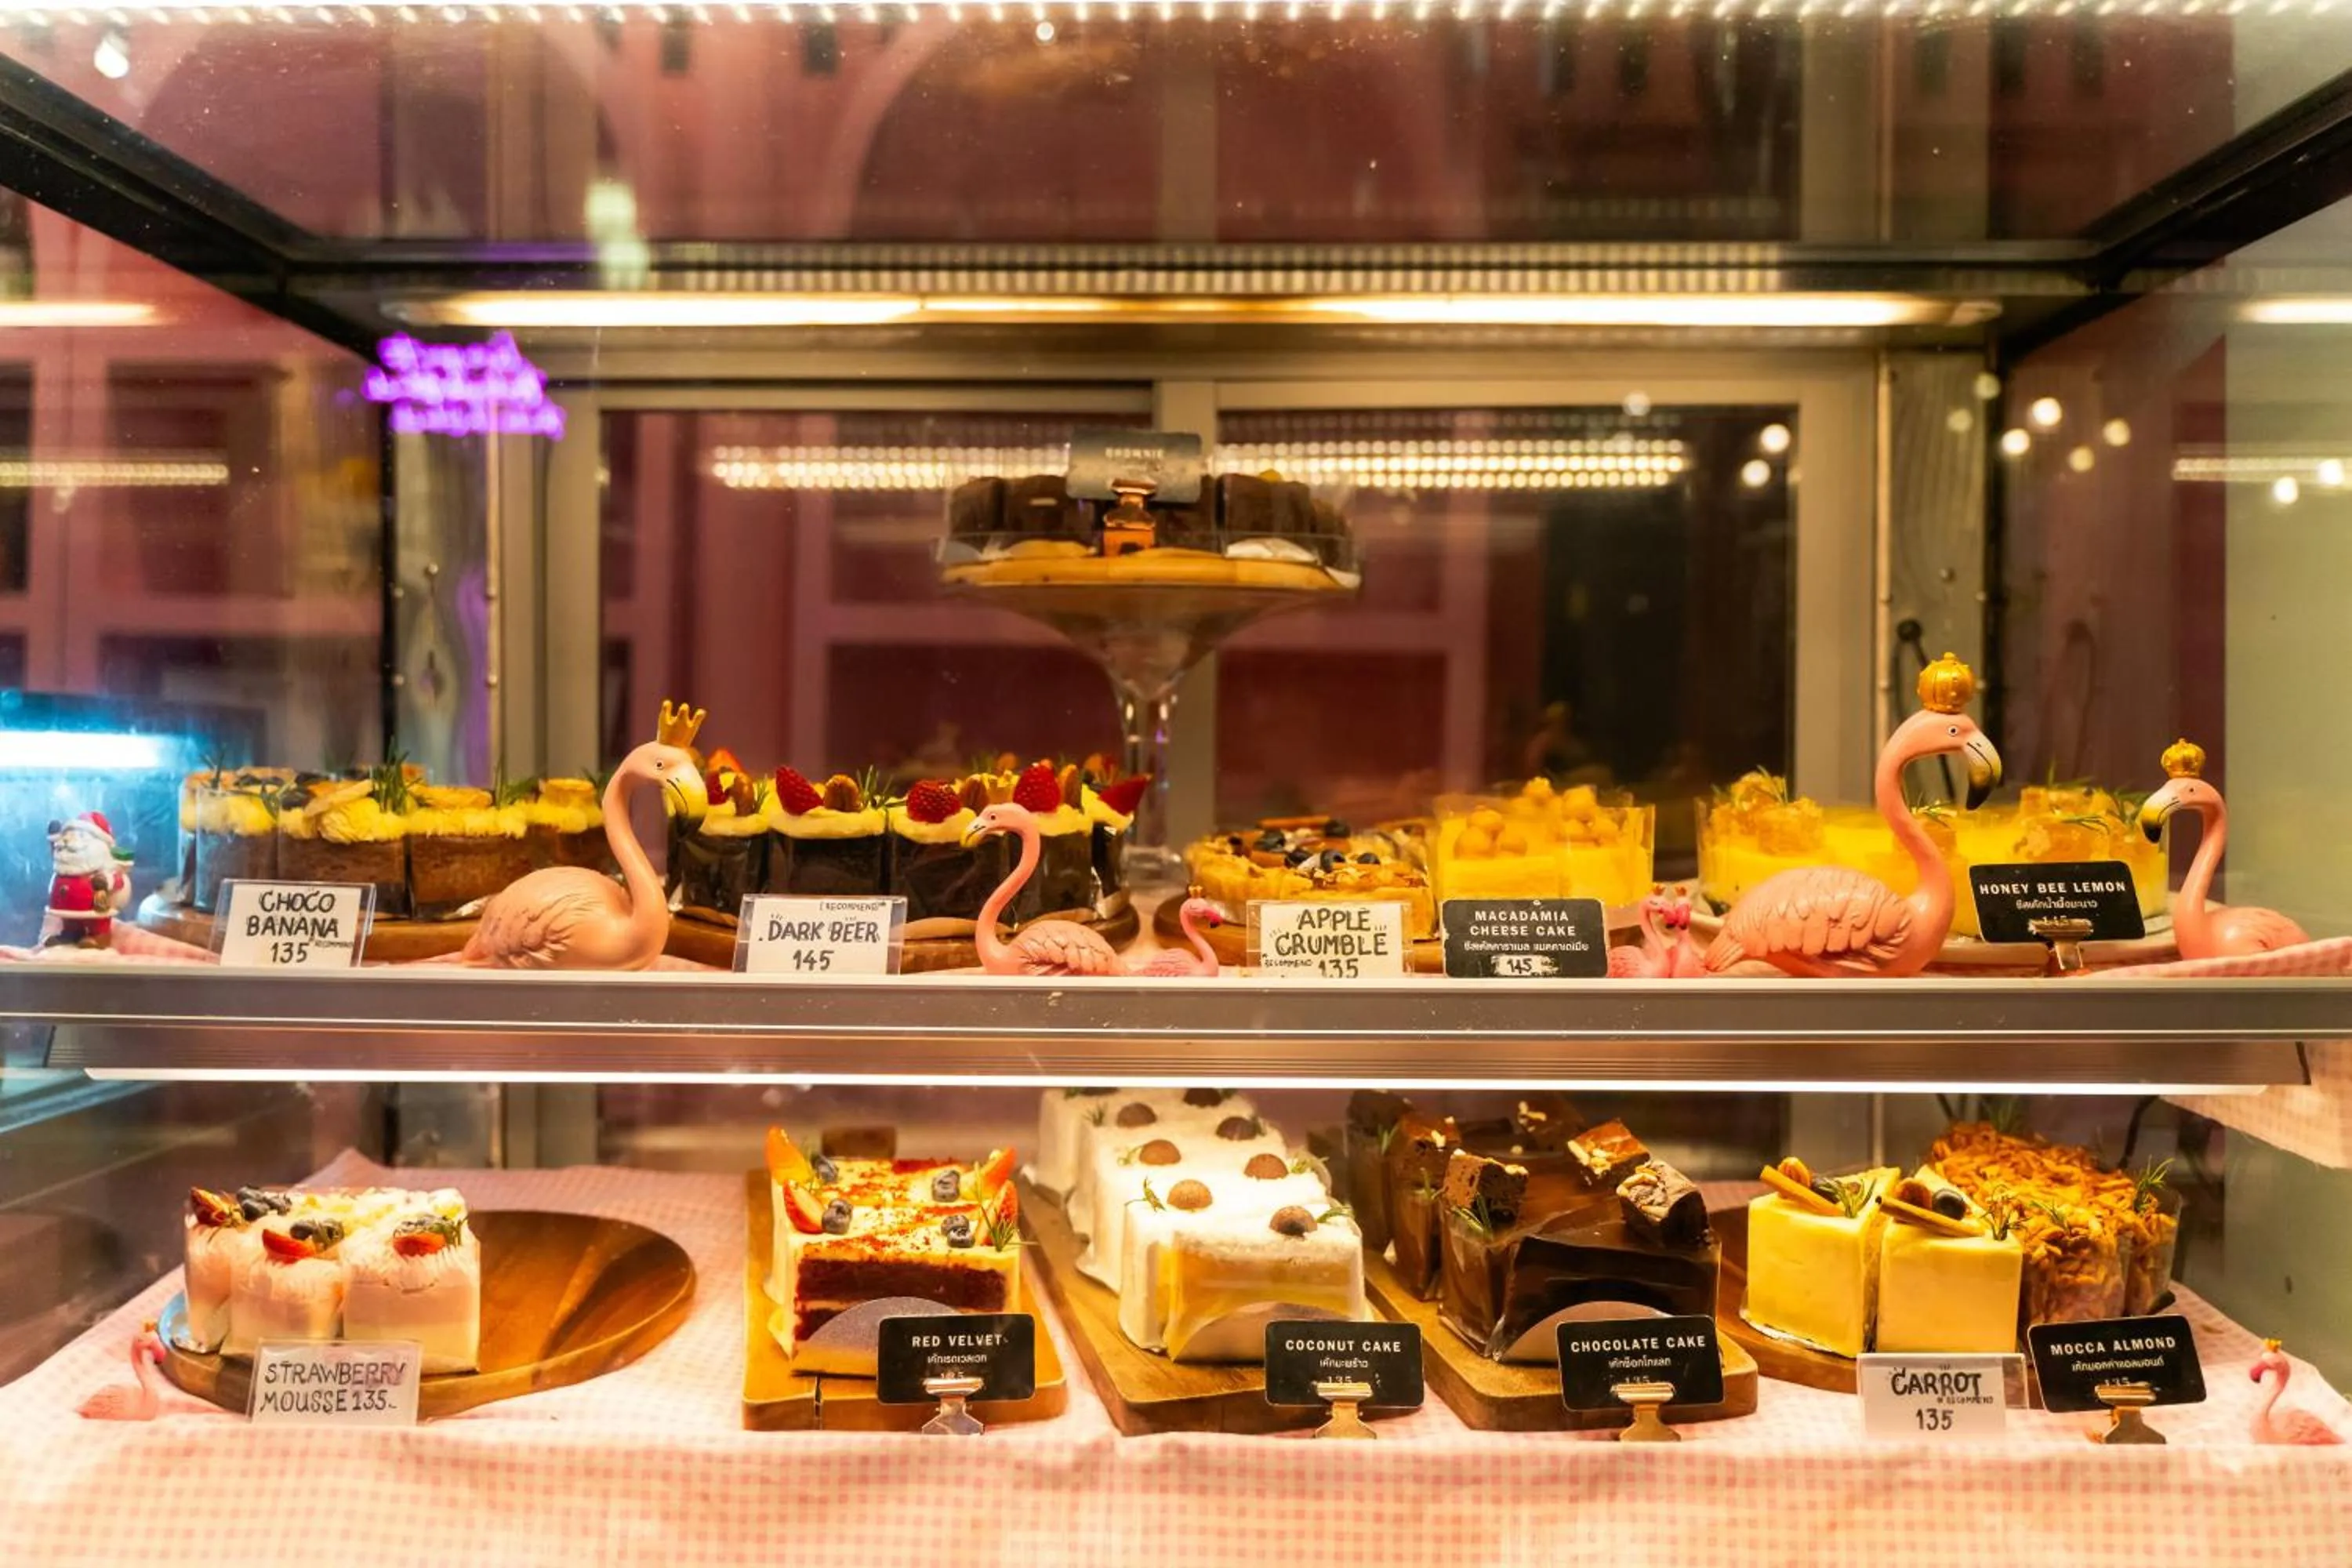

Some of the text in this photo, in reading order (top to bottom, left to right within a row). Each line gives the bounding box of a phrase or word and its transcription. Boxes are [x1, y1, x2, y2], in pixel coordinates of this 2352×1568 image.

[1980, 881, 2126, 895] HONEY BEE LEMON
[259, 891, 336, 913] CHOCO
[1298, 908, 1371, 931] APPLE
[1475, 910, 1569, 921] MACADAMIA
[246, 916, 339, 938] BANANA
[768, 920, 878, 943] DARK BEER
[1470, 926, 1576, 936] CHEESE CAKE
[270, 942, 309, 964] 135
[1275, 932, 1388, 956] CRUMBLE
[793, 949, 834, 971] 145
[1318, 958, 1359, 978] 135
[912, 1334, 1002, 1347] RED VELVET
[1285, 1340, 1402, 1352] COCONUT CAKE
[1570, 1335, 1706, 1352] CHOCOLATE CAKE
[2050, 1337, 2176, 1356] MOCCA ALMOND
[264, 1360, 406, 1386] STRAWBERRY
[1890, 1367, 1982, 1396] CARROT
[260, 1389, 347, 1413] MOUSSE
[1916, 1408, 1954, 1431] 135
